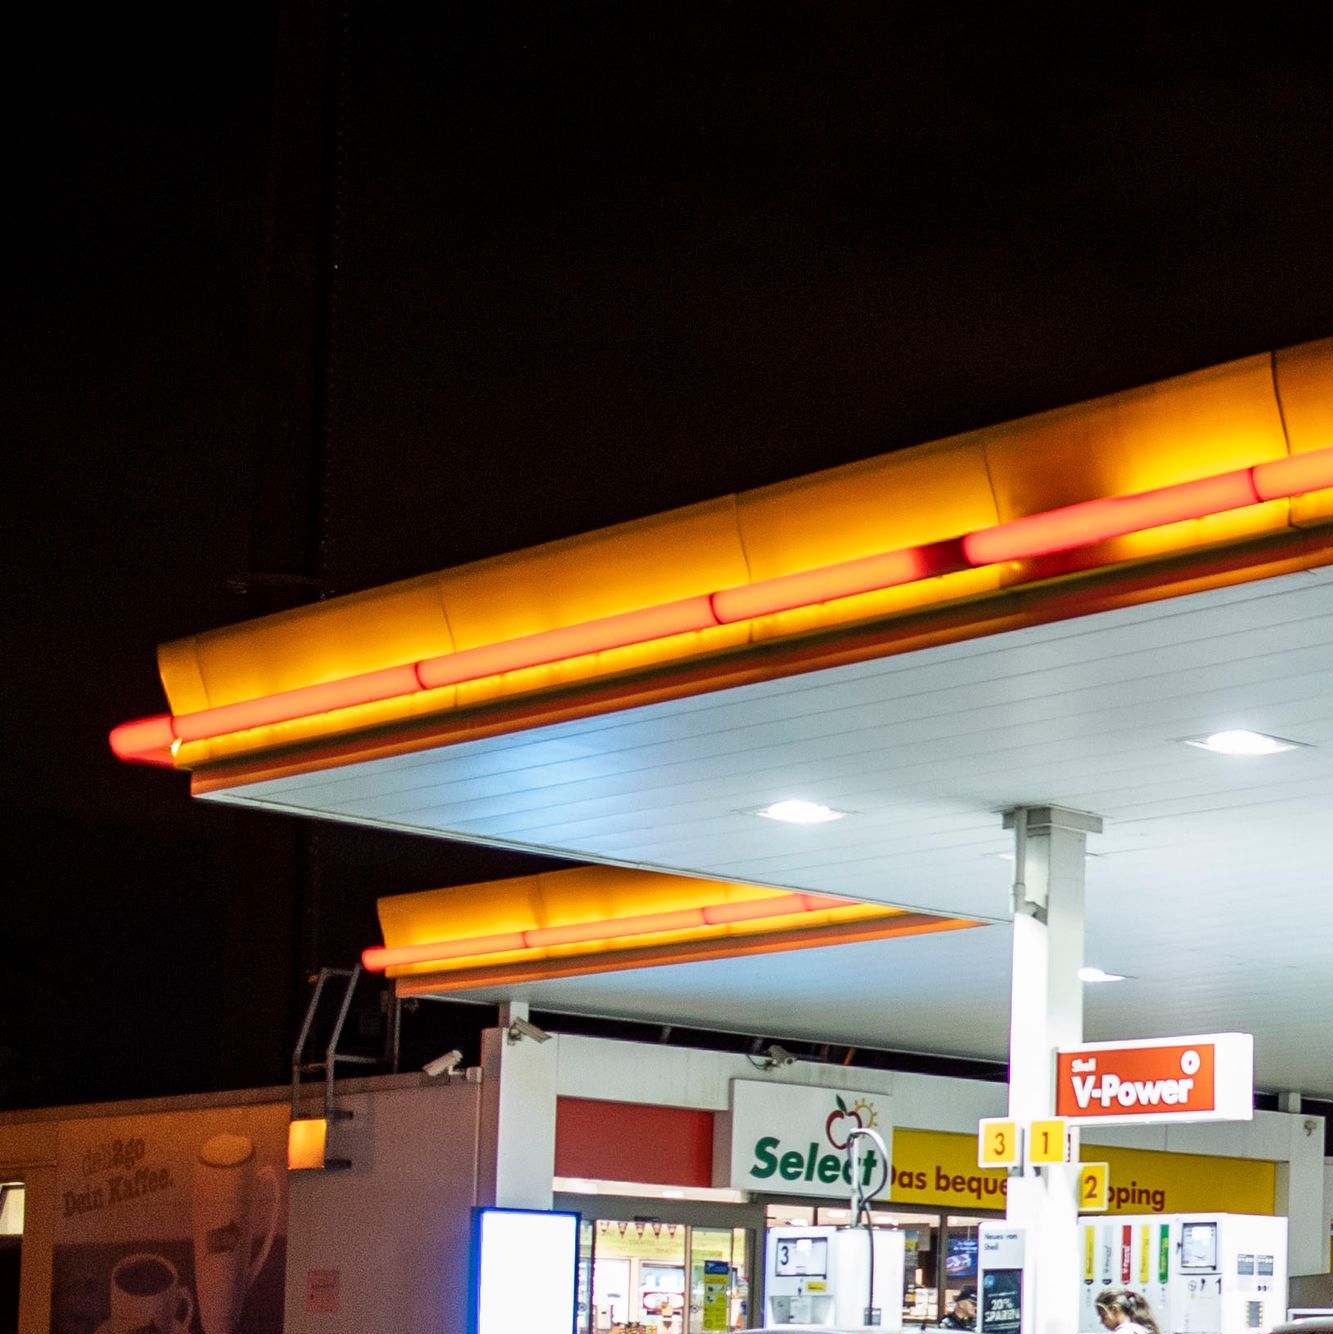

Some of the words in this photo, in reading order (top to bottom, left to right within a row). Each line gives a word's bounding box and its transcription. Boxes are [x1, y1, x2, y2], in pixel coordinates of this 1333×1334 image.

[1071, 1074, 1194, 1109] V-Power
[994, 1132, 1006, 1156] 3
[1042, 1132, 1050, 1155] 1
[750, 1137, 878, 1186] Select
[890, 1167, 926, 1189] as
[1084, 1175, 1098, 1199] 2
[780, 1246, 789, 1265] 3
[991, 1298, 1014, 1311] 20%
